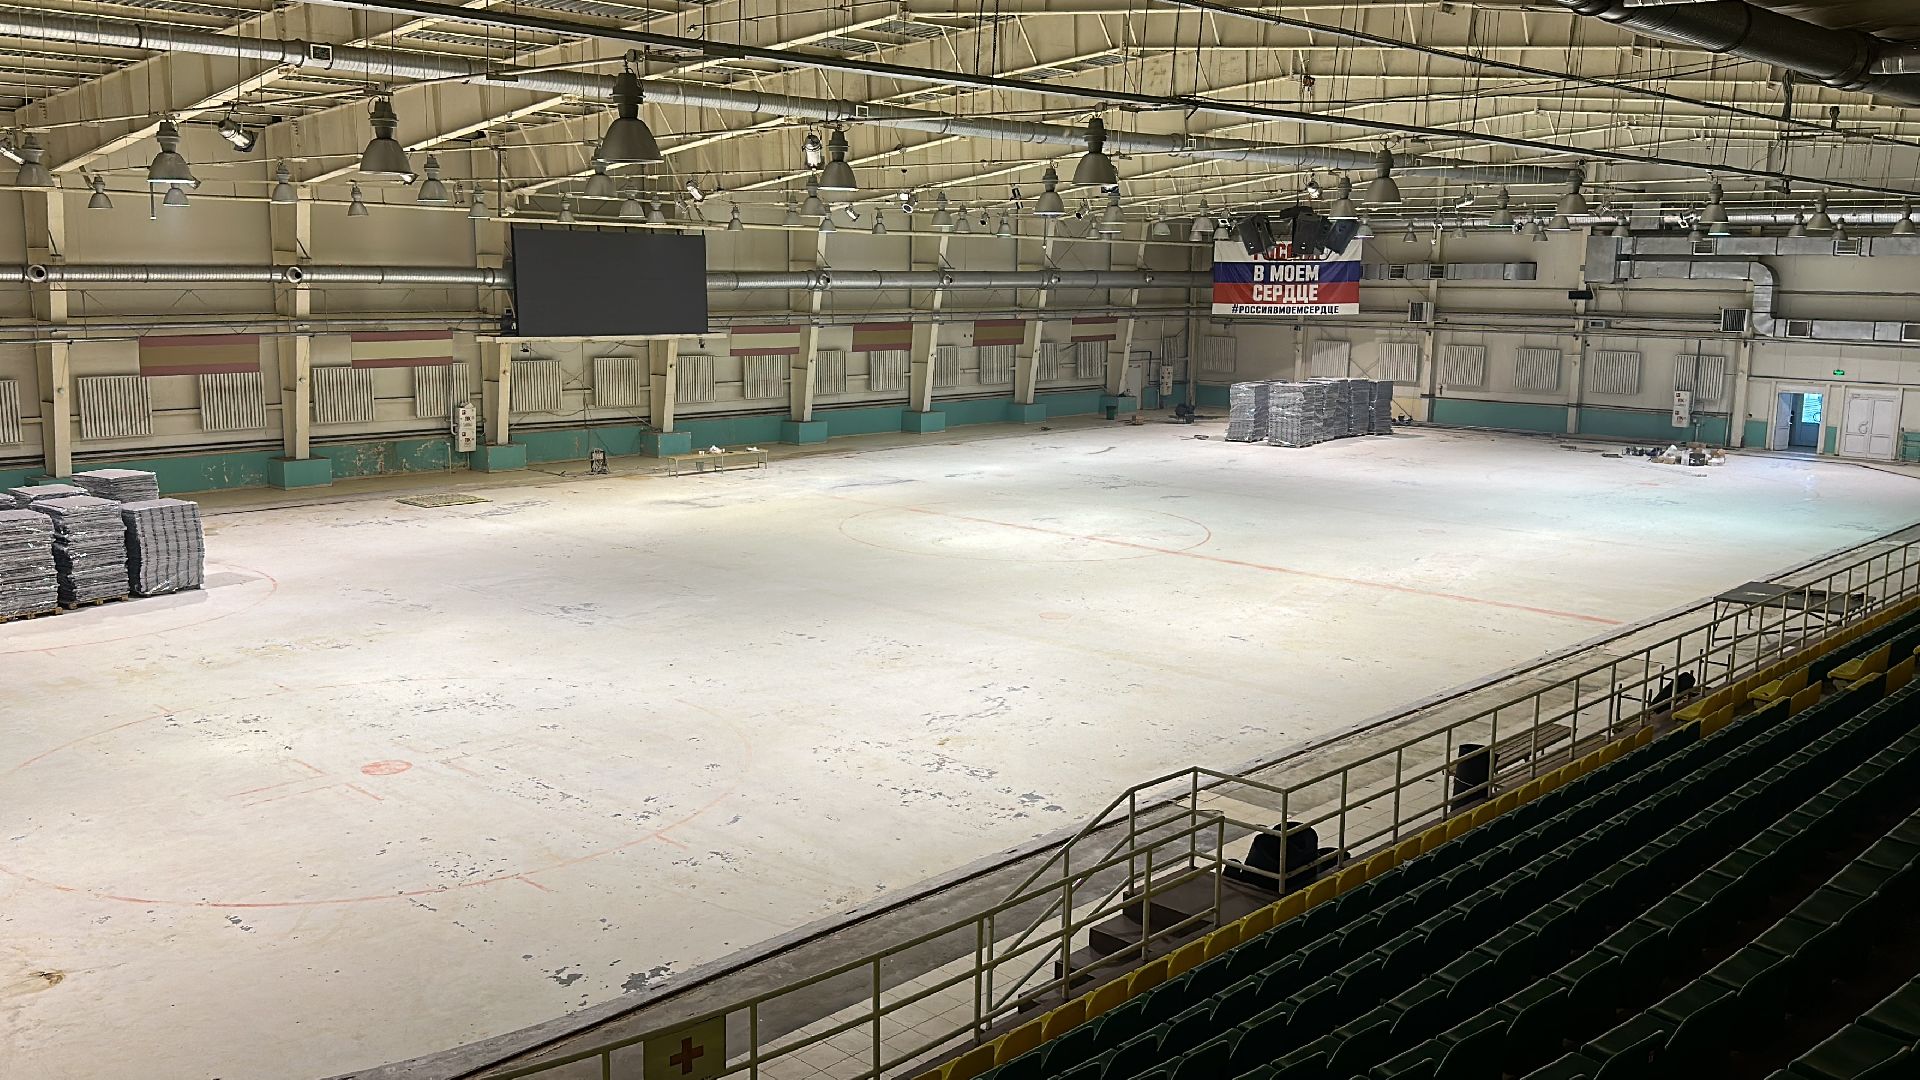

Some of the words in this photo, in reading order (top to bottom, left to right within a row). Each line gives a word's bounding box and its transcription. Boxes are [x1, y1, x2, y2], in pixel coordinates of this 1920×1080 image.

[1253, 265, 1265, 282] В
[1270, 265, 1320, 282] МОЕМ
[1253, 284, 1319, 303] СЕРДЦЕ
[1232, 304, 1339, 314] #РОССИЯВМОЕМСЕРДЦЕ
